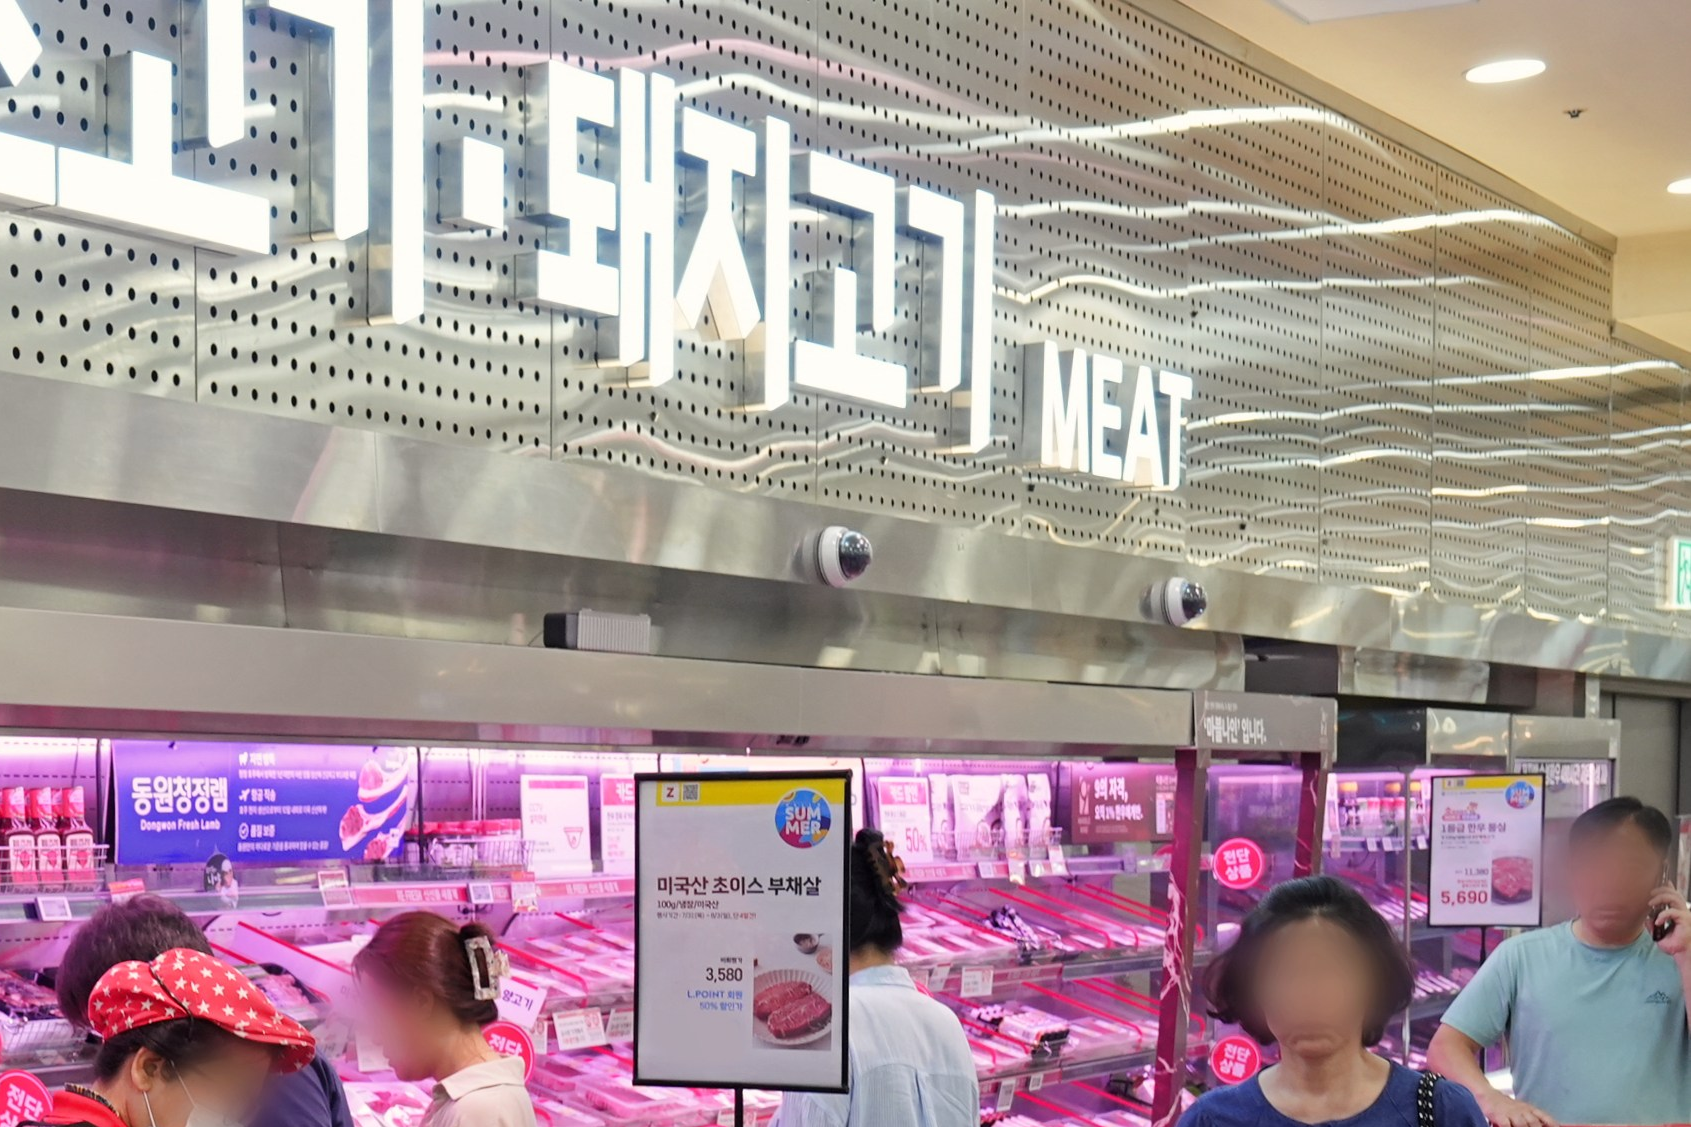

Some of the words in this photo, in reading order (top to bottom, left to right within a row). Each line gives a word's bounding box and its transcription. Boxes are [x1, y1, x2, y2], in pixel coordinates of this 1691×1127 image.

[1040, 338, 1193, 492] MEAT
[1242, 718, 1267, 745] 입니다.
[131, 776, 228, 816] 동원청정램
[666, 787, 674, 798] Z
[785, 805, 822, 821] SUM
[140, 819, 177, 833] Dongwon
[178, 819, 199, 832] Fresh
[200, 820, 221, 832] Lamb
[785, 820, 822, 836] MER
[1223, 847, 1250, 865] 전단
[1224, 863, 1253, 882] 상품
[657, 875, 709, 897] 미국산
[711, 876, 765, 896] 초이스
[767, 875, 822, 897] 부채살
[1440, 890, 1488, 907] 5,690
[705, 966, 744, 984] 3,580
[687, 989, 725, 1000] L.POINT
[1224, 1043, 1251, 1063] 전단
[1219, 1060, 1247, 1079] 상품
[7, 1083, 44, 1122] 전단
